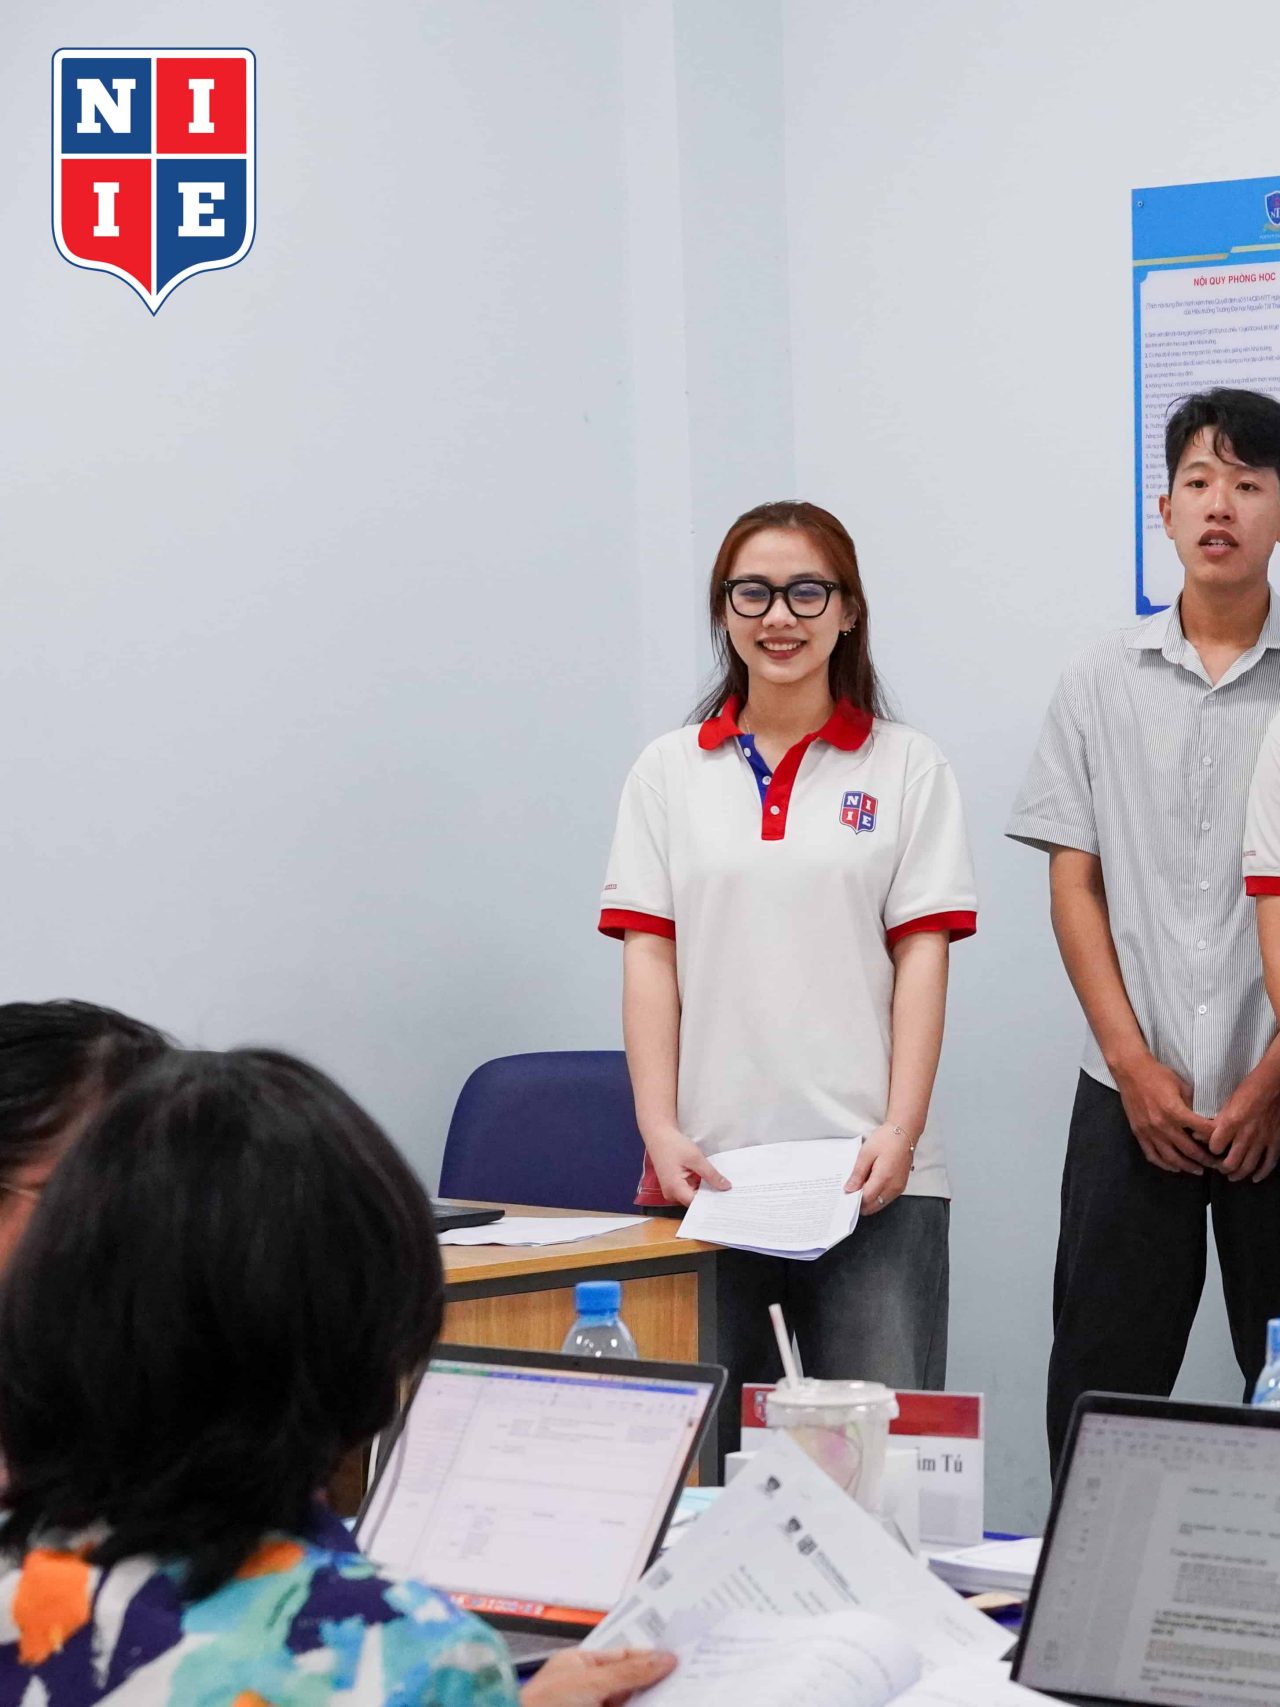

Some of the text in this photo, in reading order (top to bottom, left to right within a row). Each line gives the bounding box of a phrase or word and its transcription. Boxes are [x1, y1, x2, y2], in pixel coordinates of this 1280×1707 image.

[1193, 272, 1276, 287] NỘI QUY PHÒNG HỌC
[941, 1453, 963, 1473] Tú
